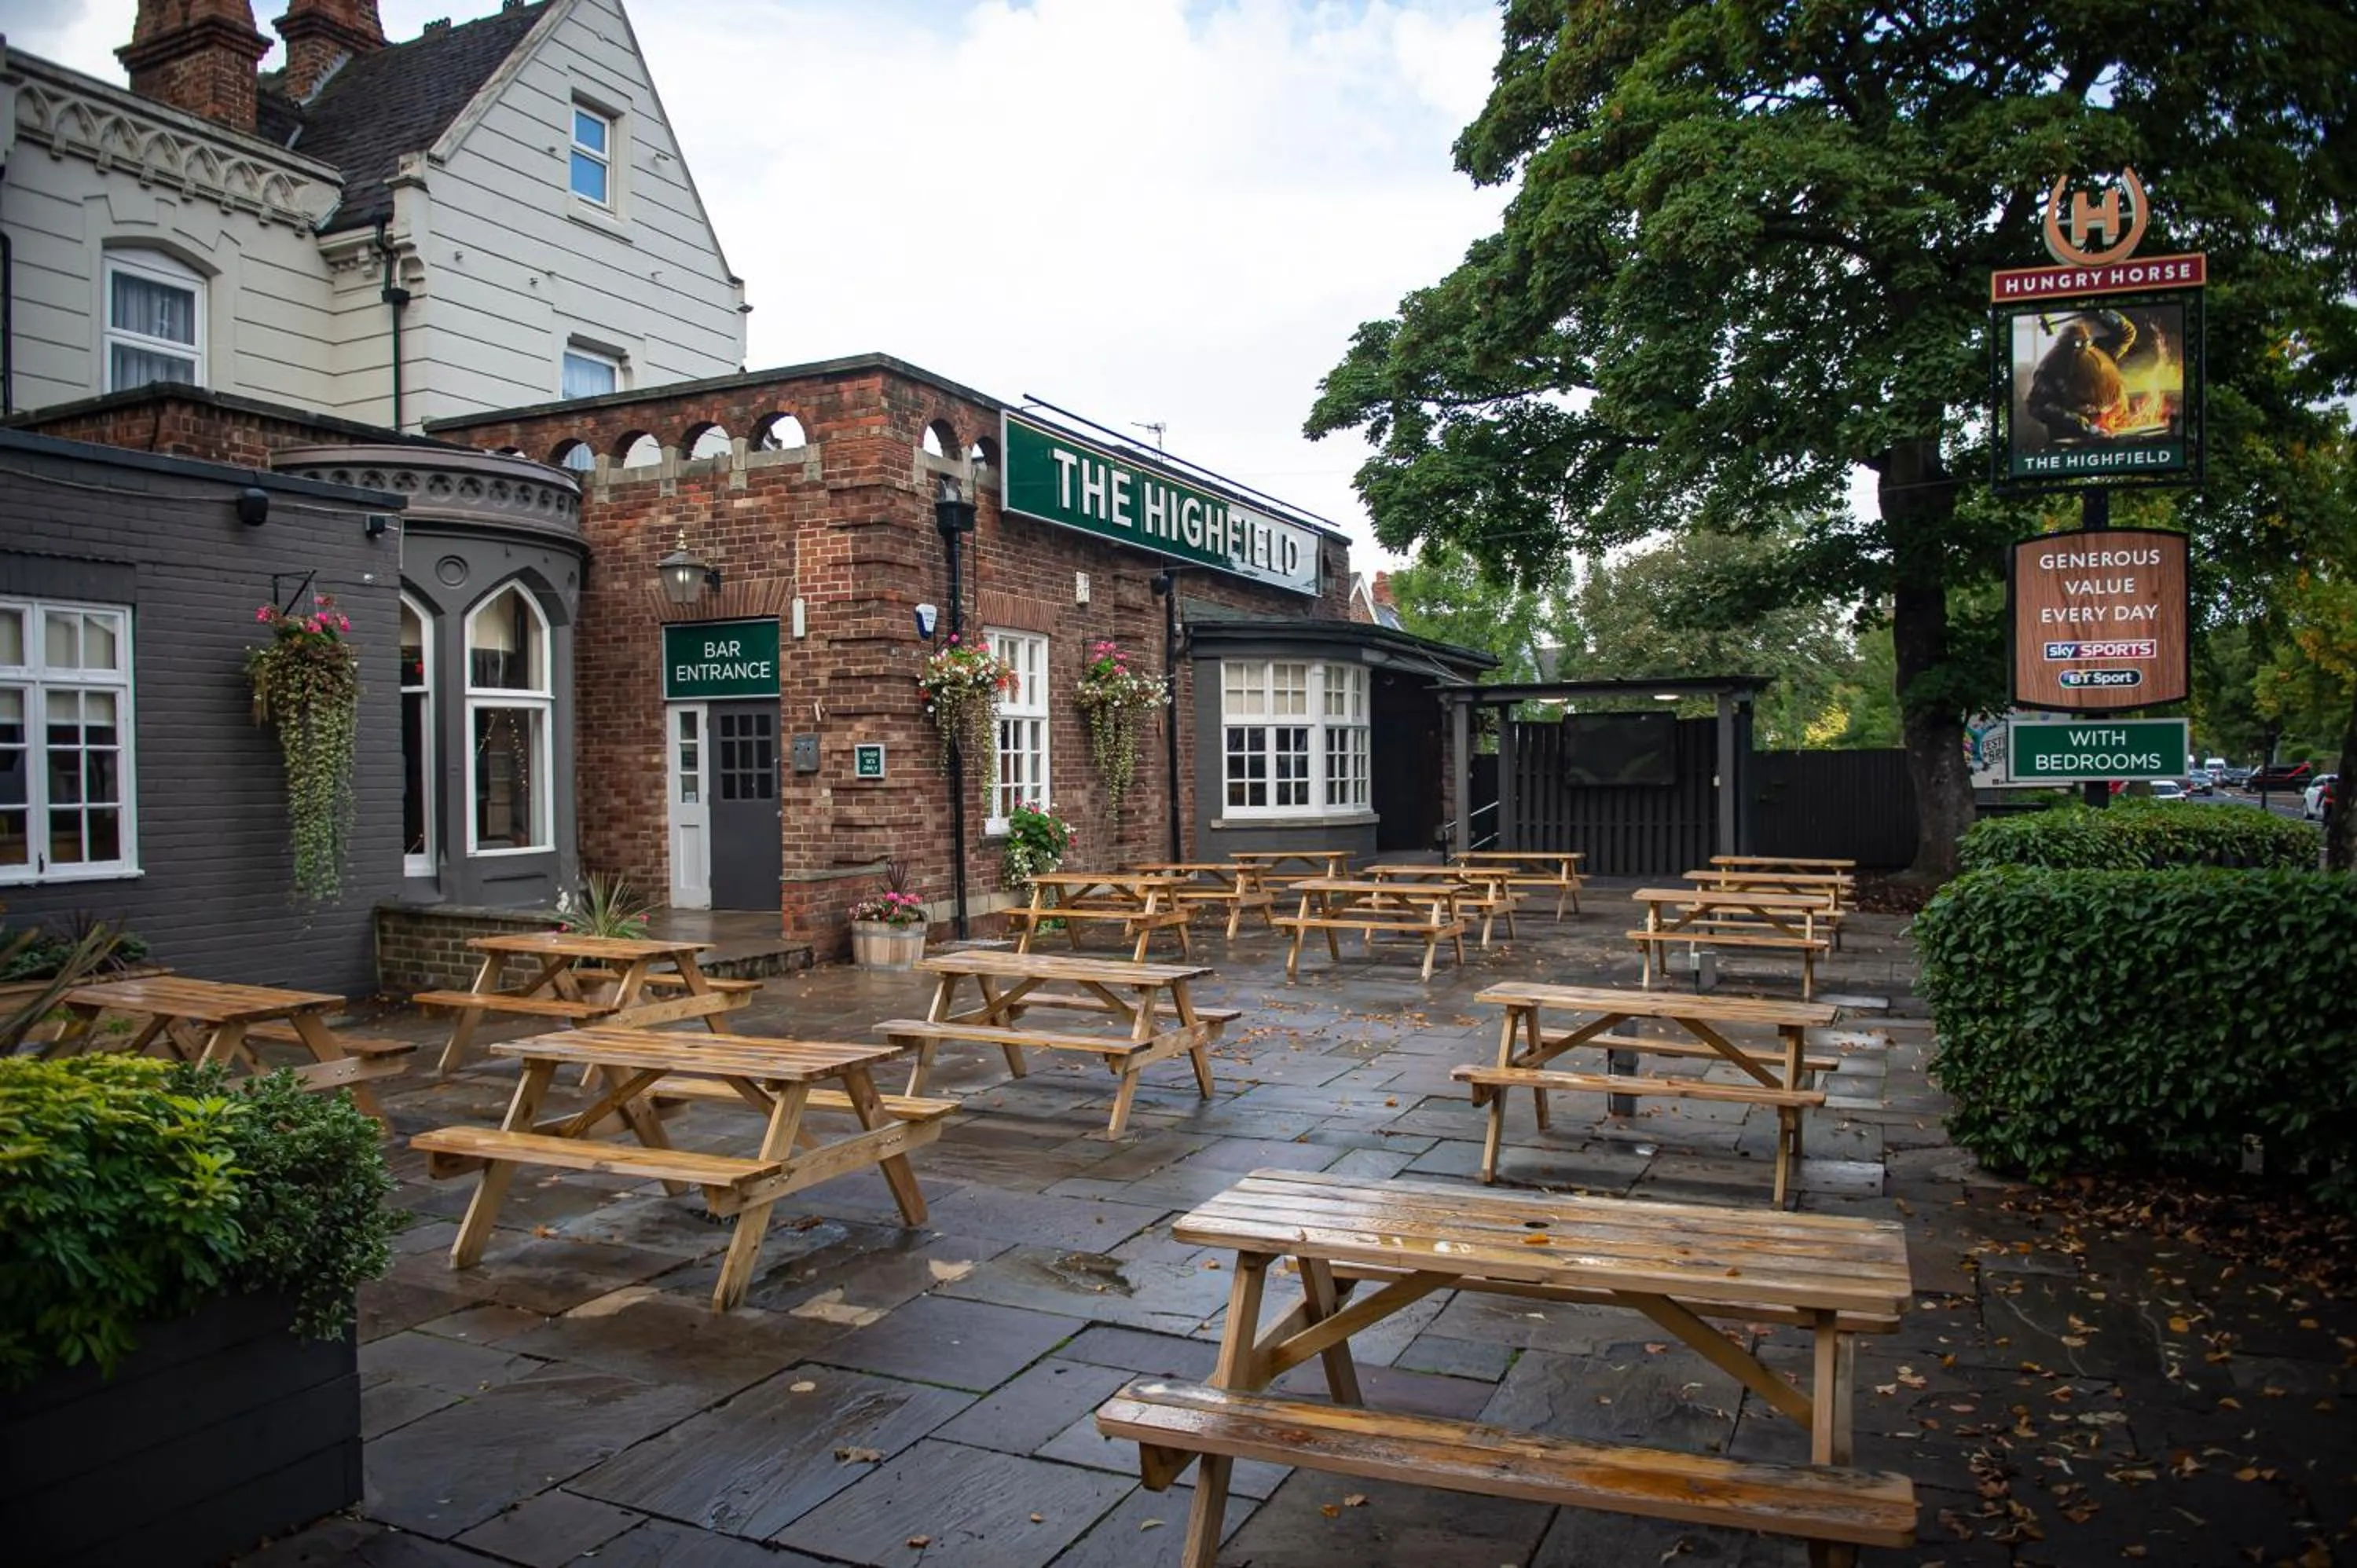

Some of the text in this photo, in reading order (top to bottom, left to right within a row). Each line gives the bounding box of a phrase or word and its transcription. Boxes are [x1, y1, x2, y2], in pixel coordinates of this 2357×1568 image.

[2005, 264, 2191, 294] HUNGRY HORSE
[2024, 450, 2172, 470] THE HIGHFIELD
[1053, 447, 1300, 577] THE HIGHFIELD
[2039, 549, 2161, 570] GENEROUS
[2065, 577, 2135, 595] VALUE
[2041, 604, 2158, 623] EVERY DAY
[704, 640, 741, 658] BAR
[2048, 643, 2152, 658] sky SPORTS
[676, 661, 772, 682] ENTRANCE
[2069, 672, 2133, 686] BT Sport
[2069, 730, 2126, 746] WITH
[2036, 753, 2161, 771] BEDROOMS
